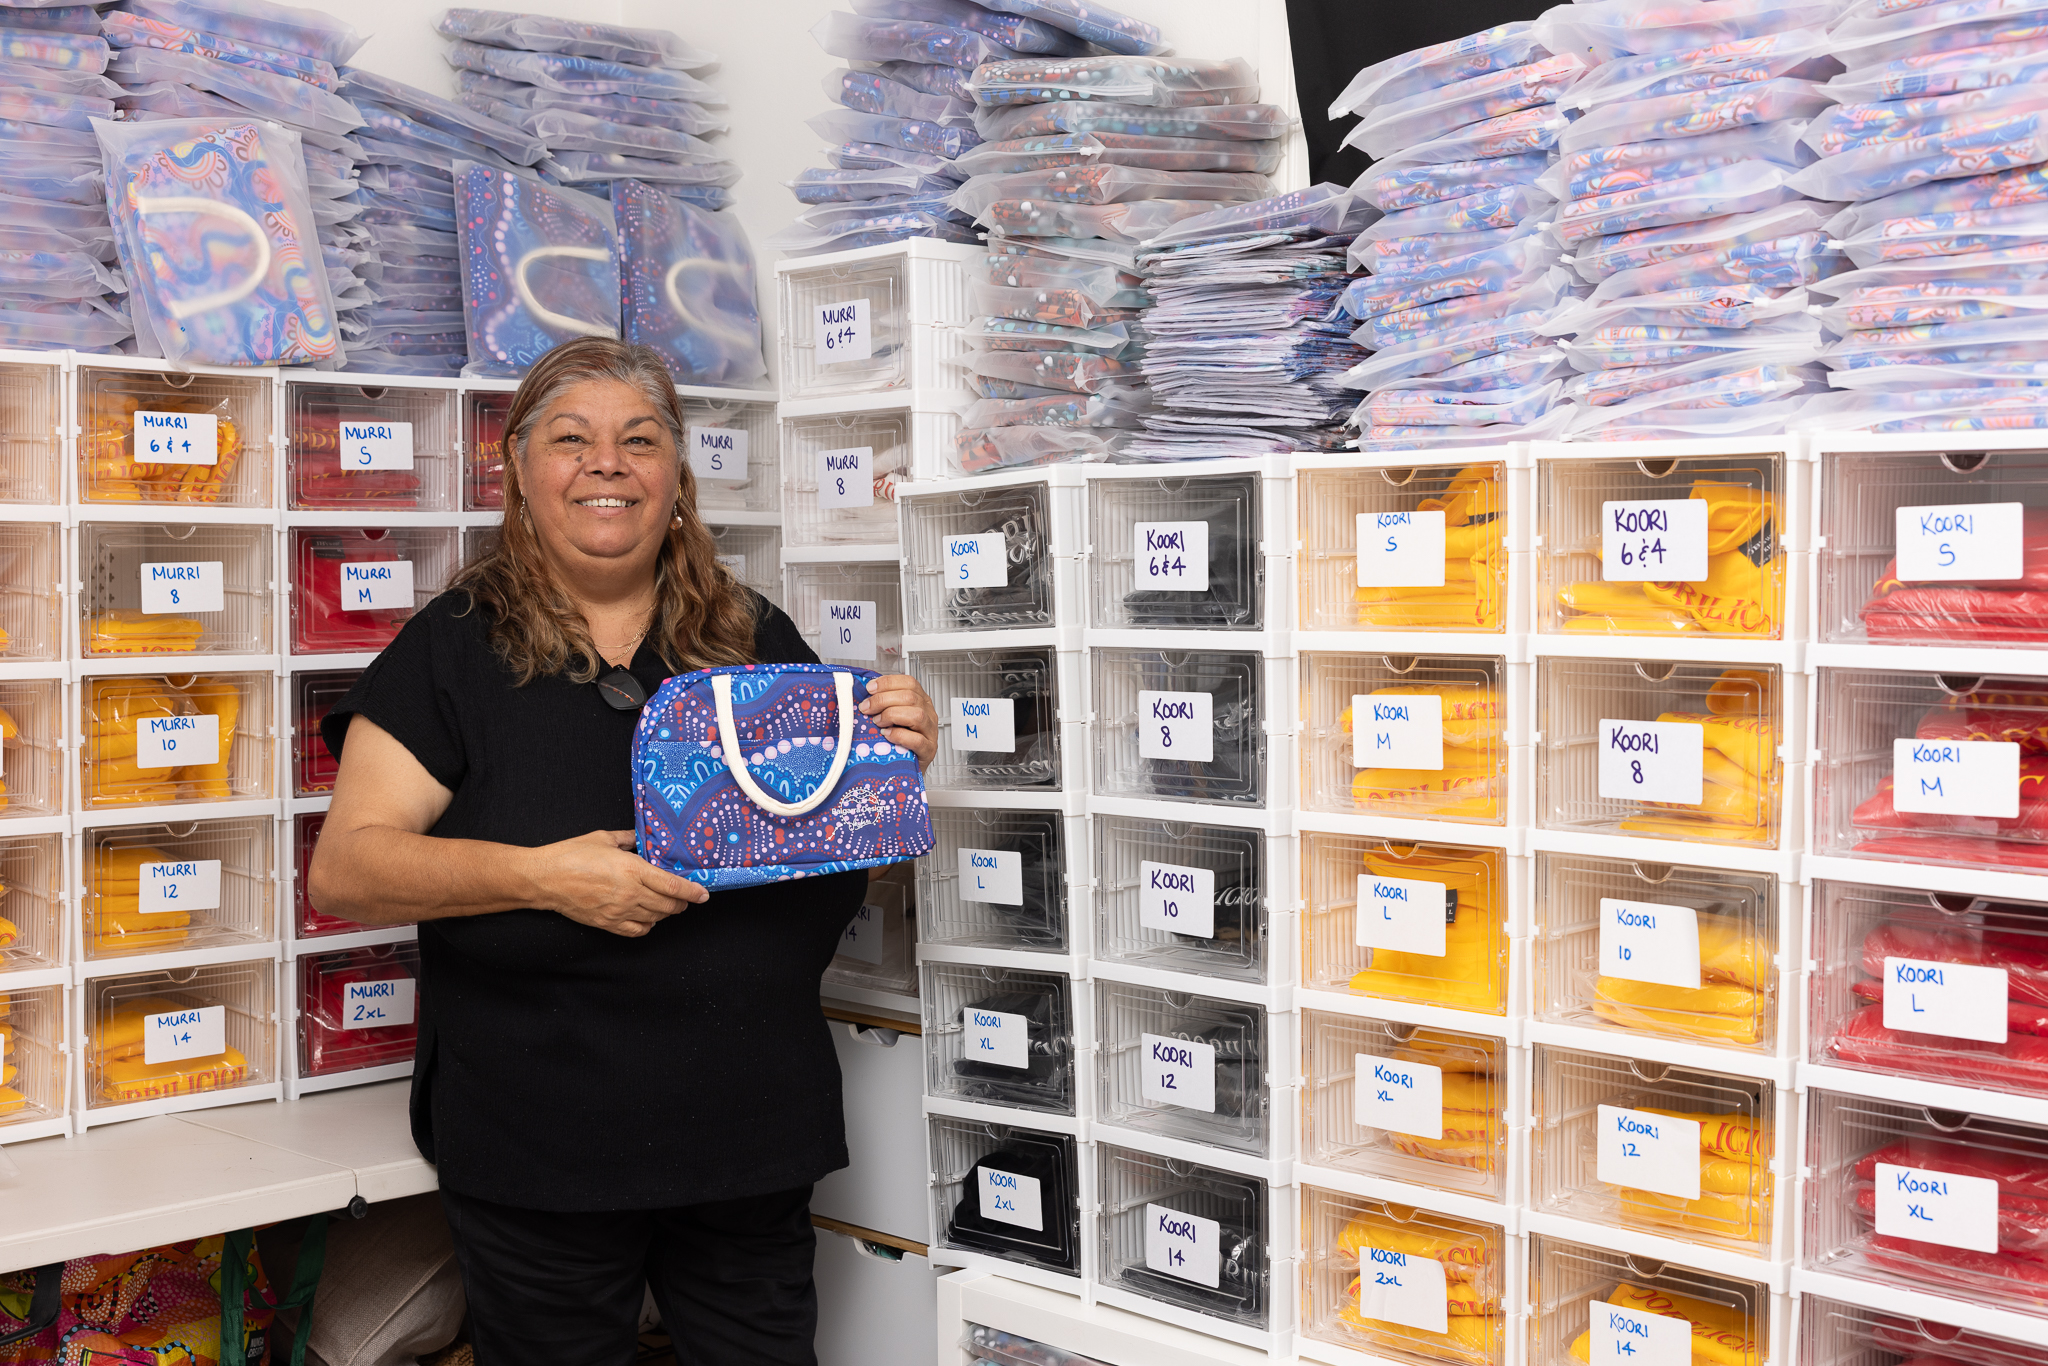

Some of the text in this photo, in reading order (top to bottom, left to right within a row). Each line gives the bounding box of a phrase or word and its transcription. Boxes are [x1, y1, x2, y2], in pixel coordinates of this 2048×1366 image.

[822, 304, 856, 326] MURRI
[143, 415, 188, 430] MURRI
[344, 425, 392, 441] MURRI
[700, 433, 733, 451] MURRI
[358, 445, 372, 466] S
[710, 453, 723, 471] S
[826, 454, 859, 472] MURRI
[835, 477, 846, 496] 8
[1377, 512, 1411, 529] KOORI
[1614, 507, 1668, 533] KOORI
[1920, 512, 1973, 536] KOORI
[950, 540, 980, 557] KOORI
[1146, 528, 1185, 553] KOORI
[1385, 536, 1398, 552] S
[1938, 542, 1956, 567] S
[152, 565, 200, 581] MURRI
[346, 566, 392, 581] MURRI
[959, 563, 969, 580] S
[170, 588, 181, 605] 8
[358, 587, 373, 604] M
[830, 604, 861, 621] MURRI
[839, 626, 852, 645] 10
[961, 700, 990, 717] KOORI
[1152, 700, 1194, 721] KOORI
[1373, 702, 1409, 722] KOORI
[150, 717, 196, 734] MURRI
[965, 723, 978, 739] M
[162, 738, 177, 751] 10
[1160, 725, 1173, 748] 8
[1376, 732, 1392, 750] M
[1611, 725, 1659, 755] KOORI
[1912, 743, 1961, 763] KOORI
[1630, 759, 1644, 785] 8
[1920, 776, 1944, 797] M
[970, 852, 998, 870] KOORI
[152, 863, 197, 879] MURRI
[977, 875, 986, 890] L
[1151, 868, 1195, 894] KOORI
[163, 883, 179, 899] 12
[1373, 882, 1408, 903] KOORI
[1163, 899, 1179, 918] 10
[1383, 905, 1392, 921] L
[1616, 908, 1656, 930] KOORI
[1618, 945, 1632, 961] 10
[1896, 963, 1944, 986] KOORI
[350, 982, 395, 1000] MURRI
[1911, 993, 1925, 1013] L
[157, 1011, 201, 1029] MURRI
[973, 1011, 1002, 1029] KOORI
[173, 1031, 192, 1046] 14
[979, 1037, 995, 1051] XL
[1152, 1041, 1193, 1069] KOORI
[1161, 1073, 1178, 1090] 12
[1374, 1064, 1413, 1089] KOORI
[1376, 1089, 1394, 1102] XL
[1617, 1115, 1659, 1140] KOORI
[1621, 1142, 1641, 1157] 12
[988, 1171, 1017, 1191] KOORI
[1897, 1171, 1948, 1196] KOORI
[1907, 1204, 1934, 1222] XL
[1159, 1213, 1196, 1244] KOORI
[1168, 1247, 1186, 1267] 14
[1370, 1247, 1407, 1267] KOORI
[1609, 1312, 1649, 1338] KOORI
[1616, 1339, 1637, 1357] 14
